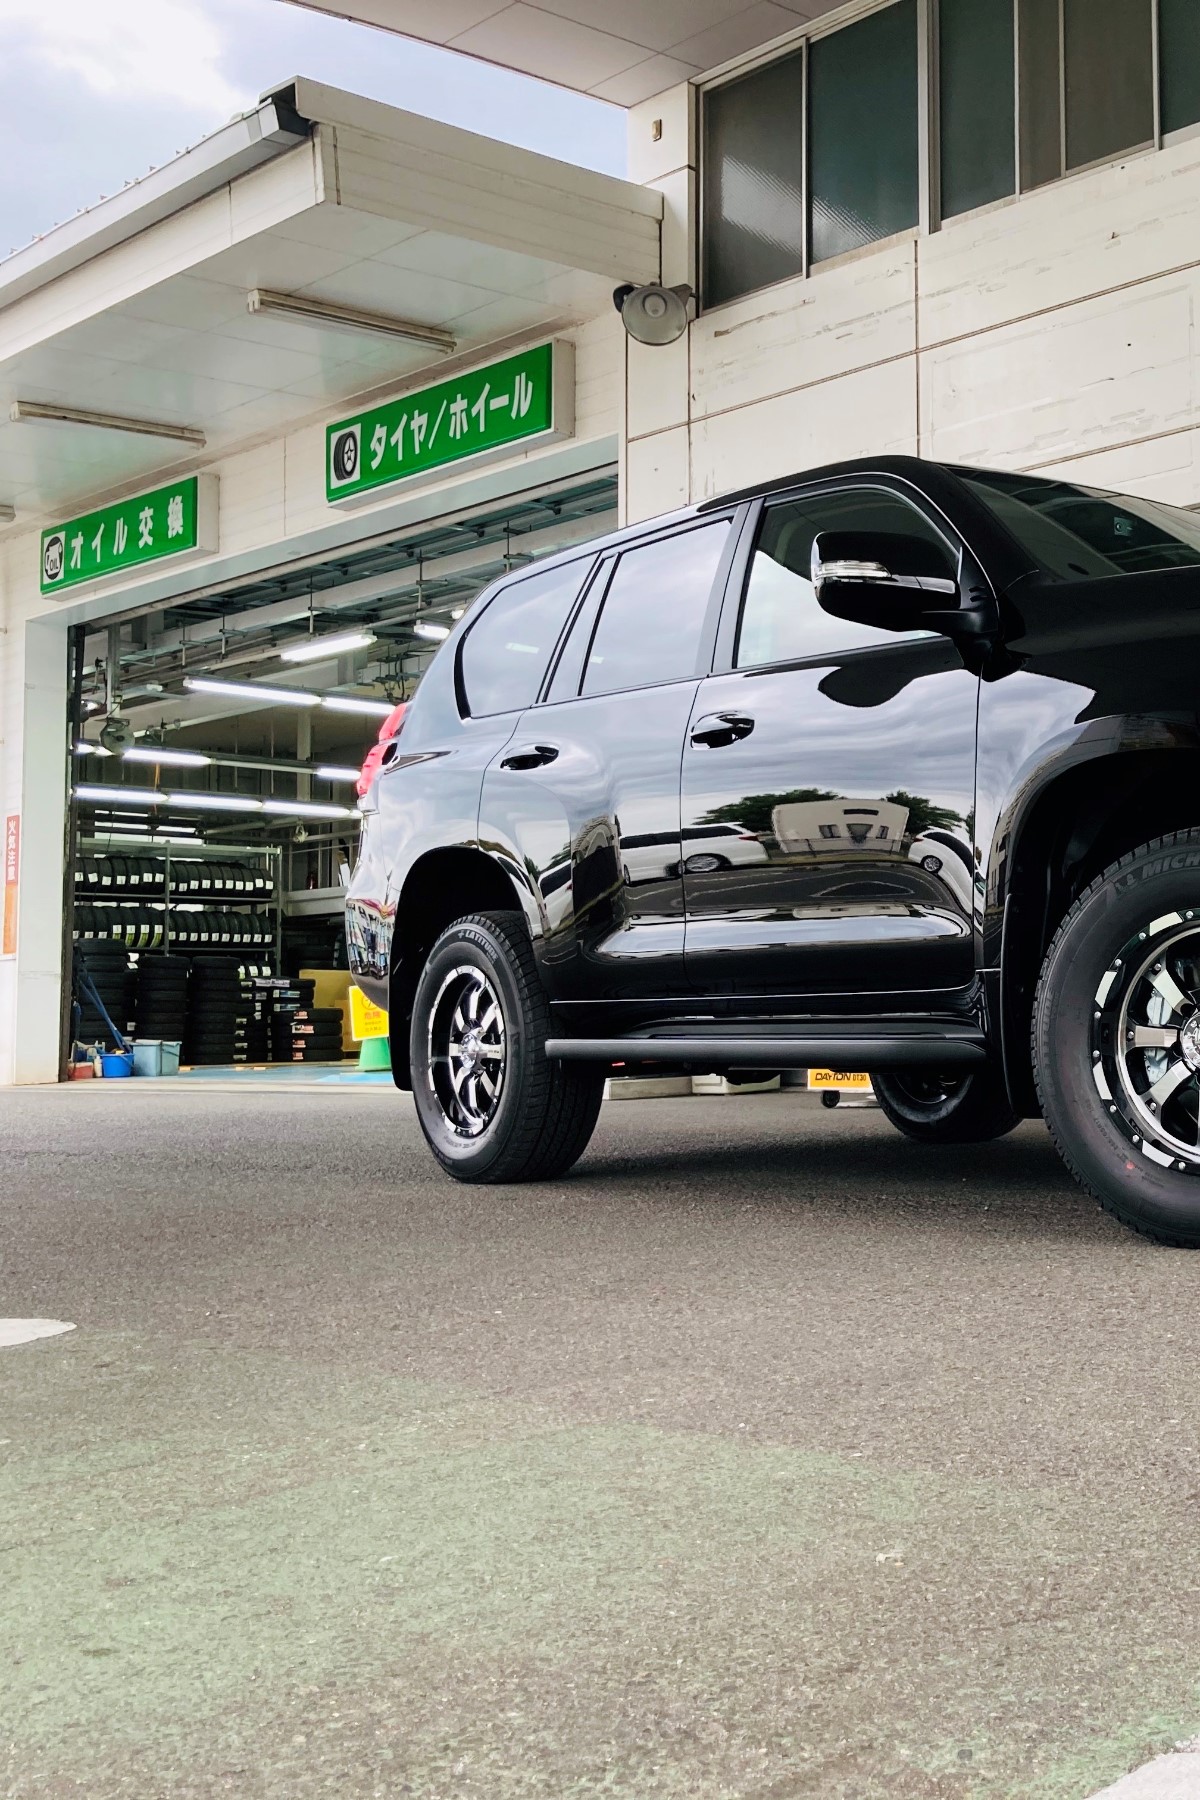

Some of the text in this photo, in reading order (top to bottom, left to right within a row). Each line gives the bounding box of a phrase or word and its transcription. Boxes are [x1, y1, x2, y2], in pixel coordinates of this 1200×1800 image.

[369, 371, 534, 472] タイヤ/ホイール
[69, 494, 185, 569] オイル交換
[49, 557, 60, 571] OIL
[465, 929, 499, 962] LATITUDE
[815, 1072, 851, 1081] DAYTON
